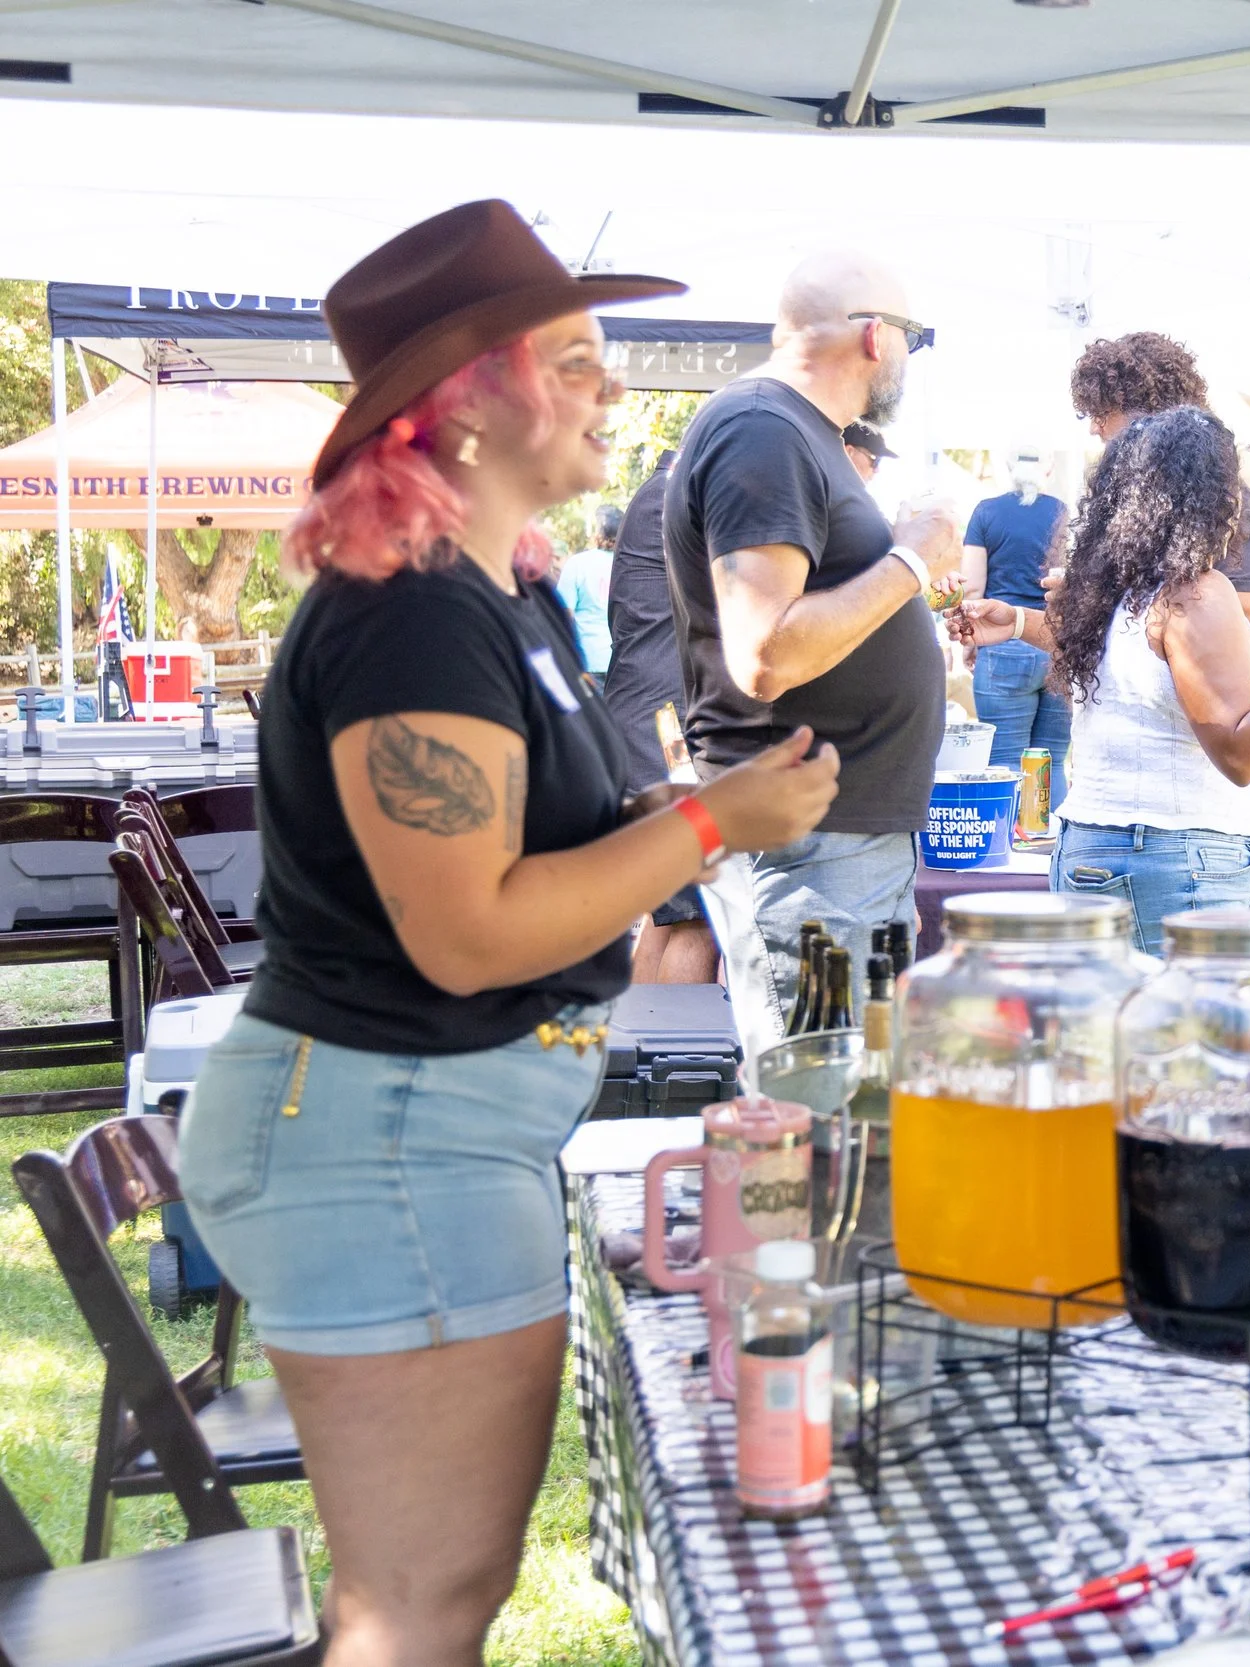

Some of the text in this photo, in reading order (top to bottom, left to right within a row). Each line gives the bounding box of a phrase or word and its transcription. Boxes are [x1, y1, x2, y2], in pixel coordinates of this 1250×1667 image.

[137, 476, 291, 497] BREWING
[928, 807, 981, 820] OFFICIAL
[942, 821, 997, 834] SPONSOR
[928, 834, 986, 848] OF THE NFL
